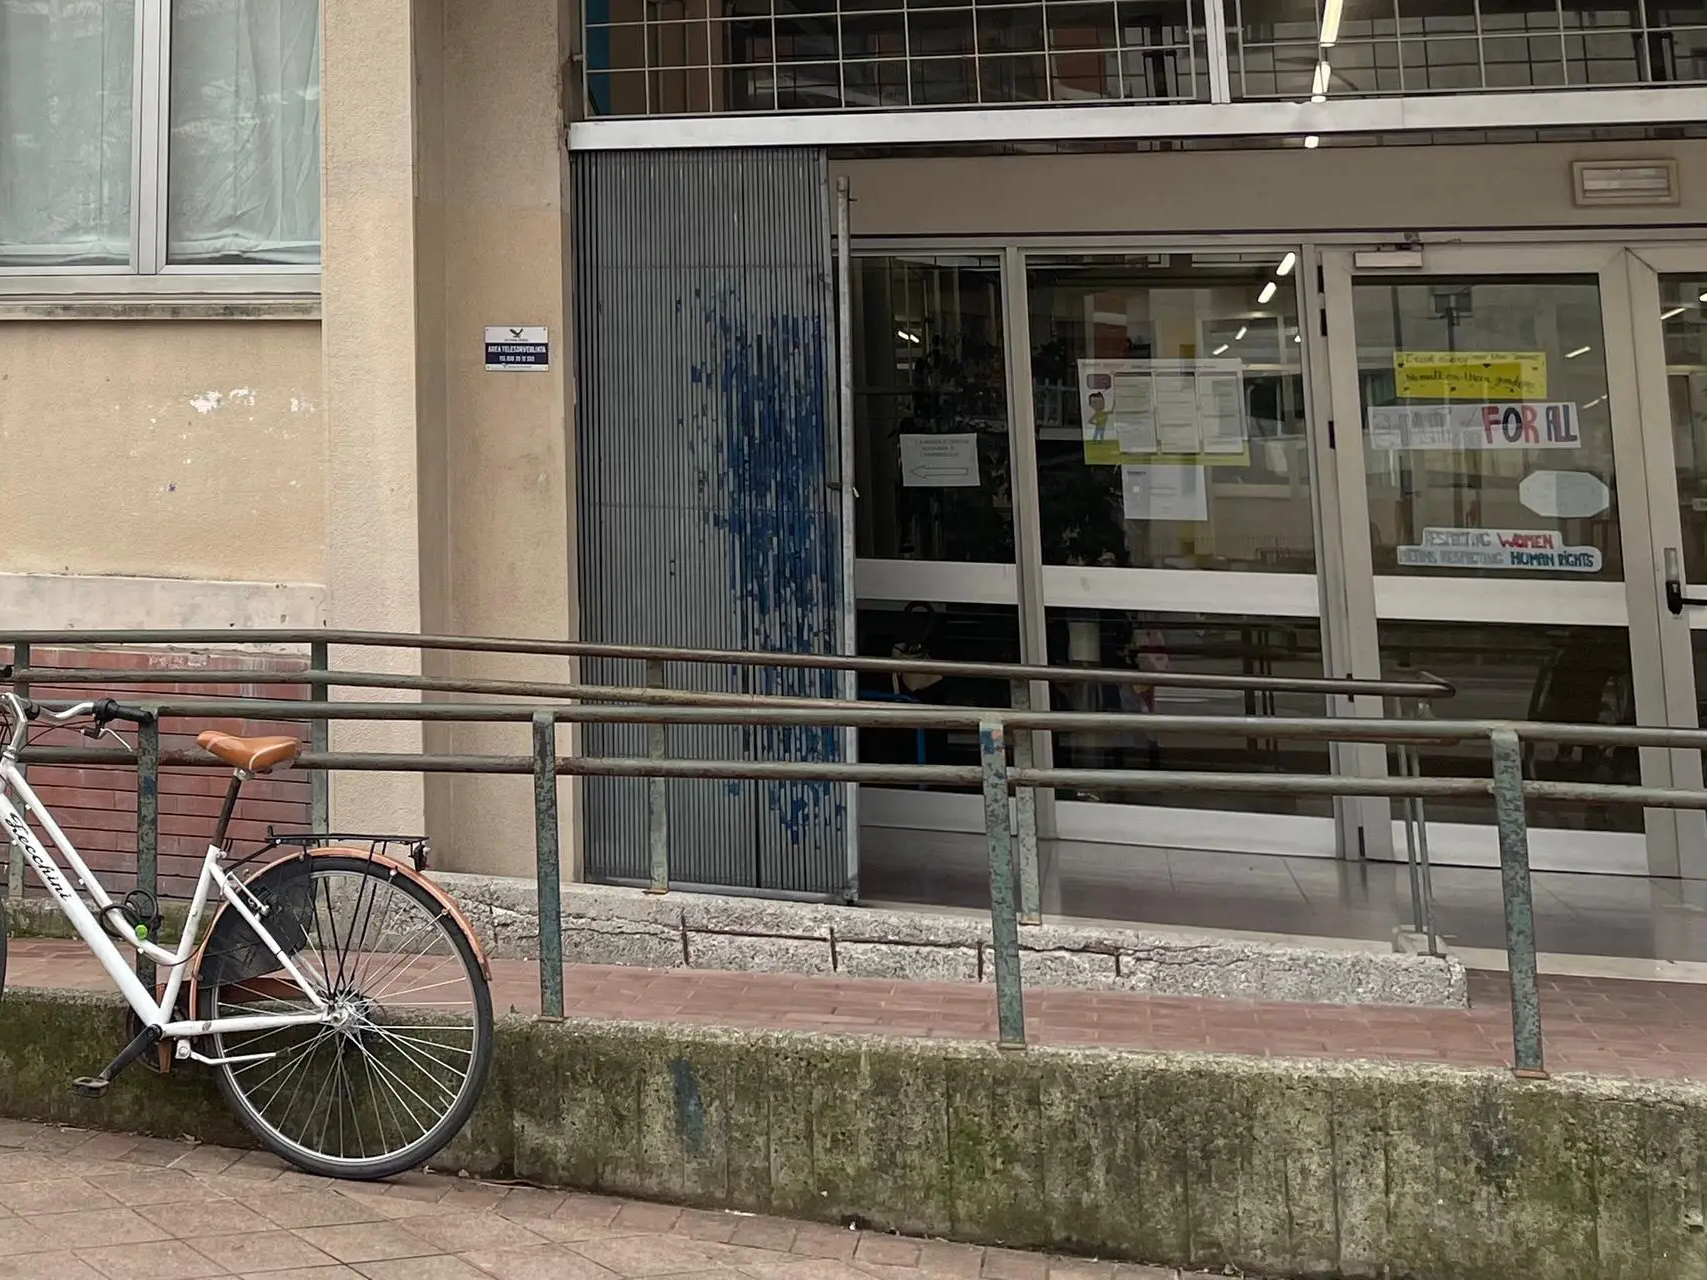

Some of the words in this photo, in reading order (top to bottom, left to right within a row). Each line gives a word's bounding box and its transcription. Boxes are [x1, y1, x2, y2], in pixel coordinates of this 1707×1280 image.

[1481, 405, 1539, 444] FOR
[1545, 404, 1579, 443] ALL
[1497, 532, 1553, 549] WOMEN
[1510, 551, 1555, 567] HUMAN
[5, 812, 71, 901] Zecchini
